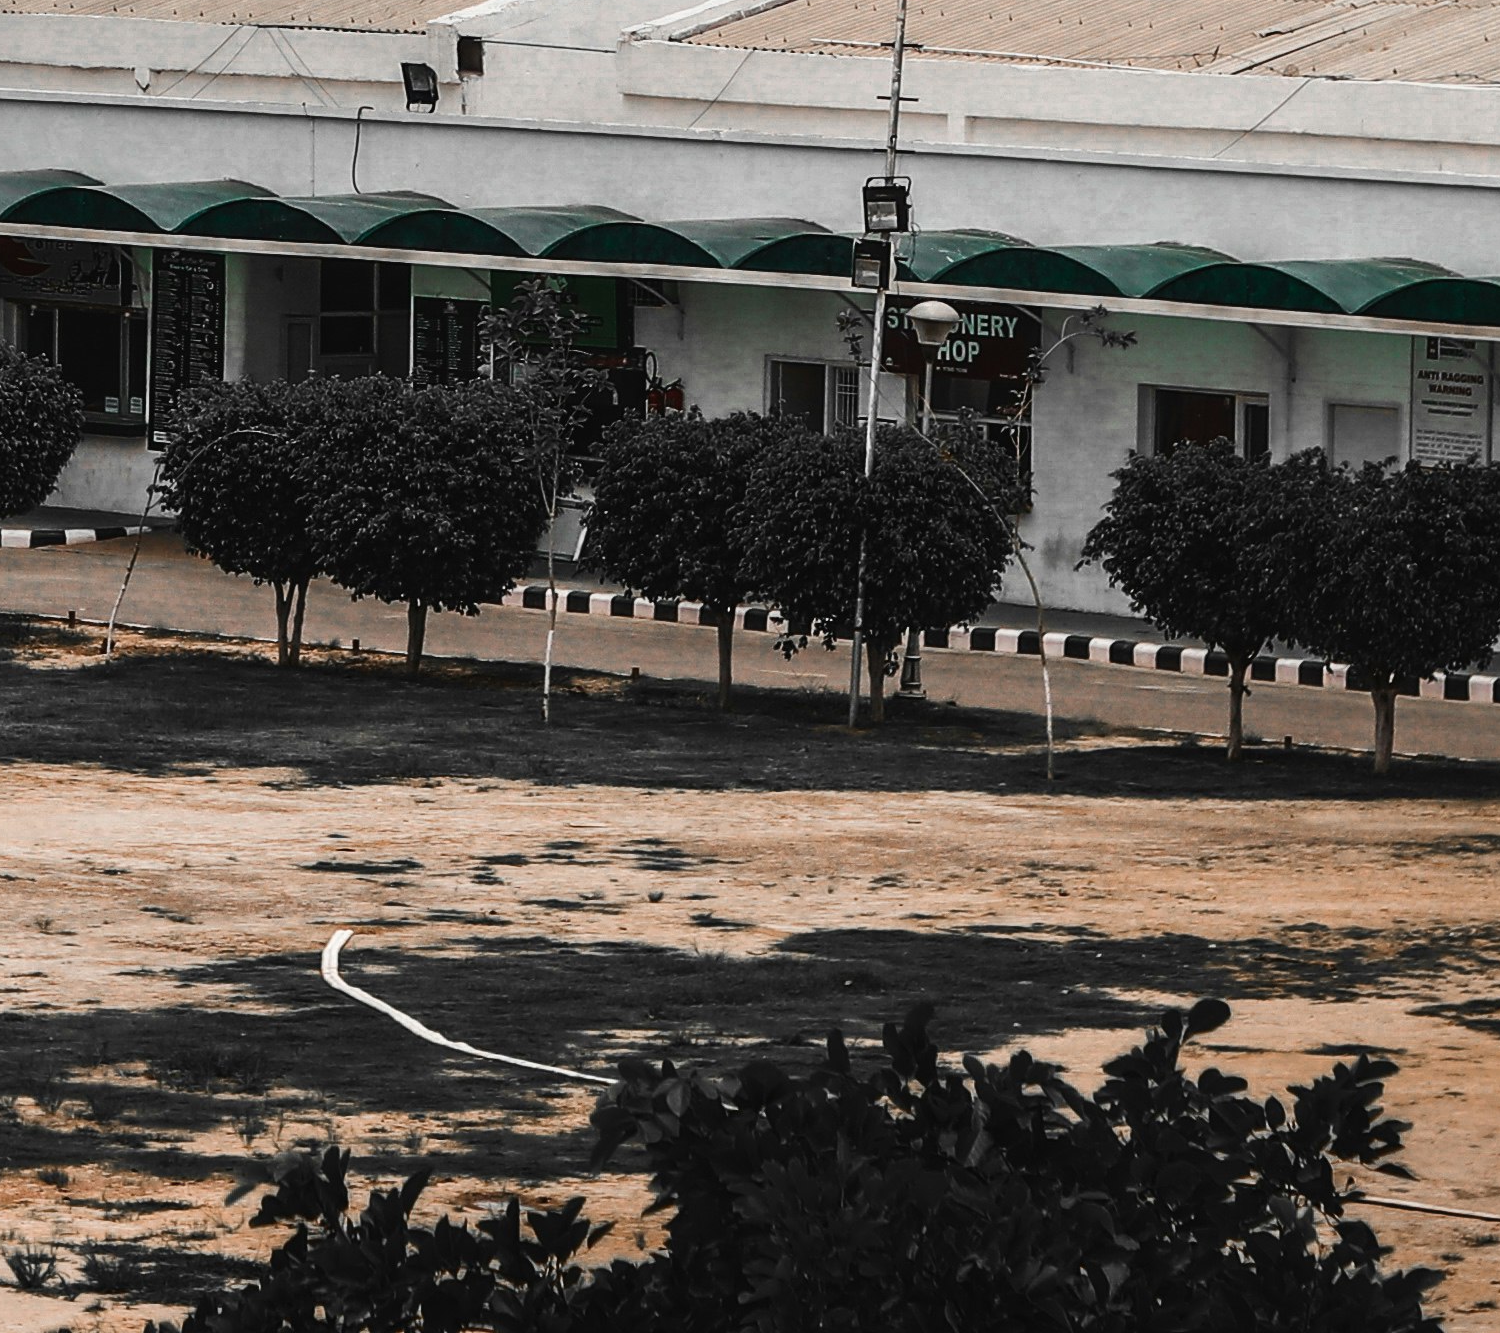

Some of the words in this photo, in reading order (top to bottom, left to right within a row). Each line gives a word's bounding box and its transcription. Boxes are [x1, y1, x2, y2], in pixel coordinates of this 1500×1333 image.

[886, 306, 1018, 338] STNERY
[937, 339, 980, 363] HOP
[1429, 384, 1473, 396] WARNING
